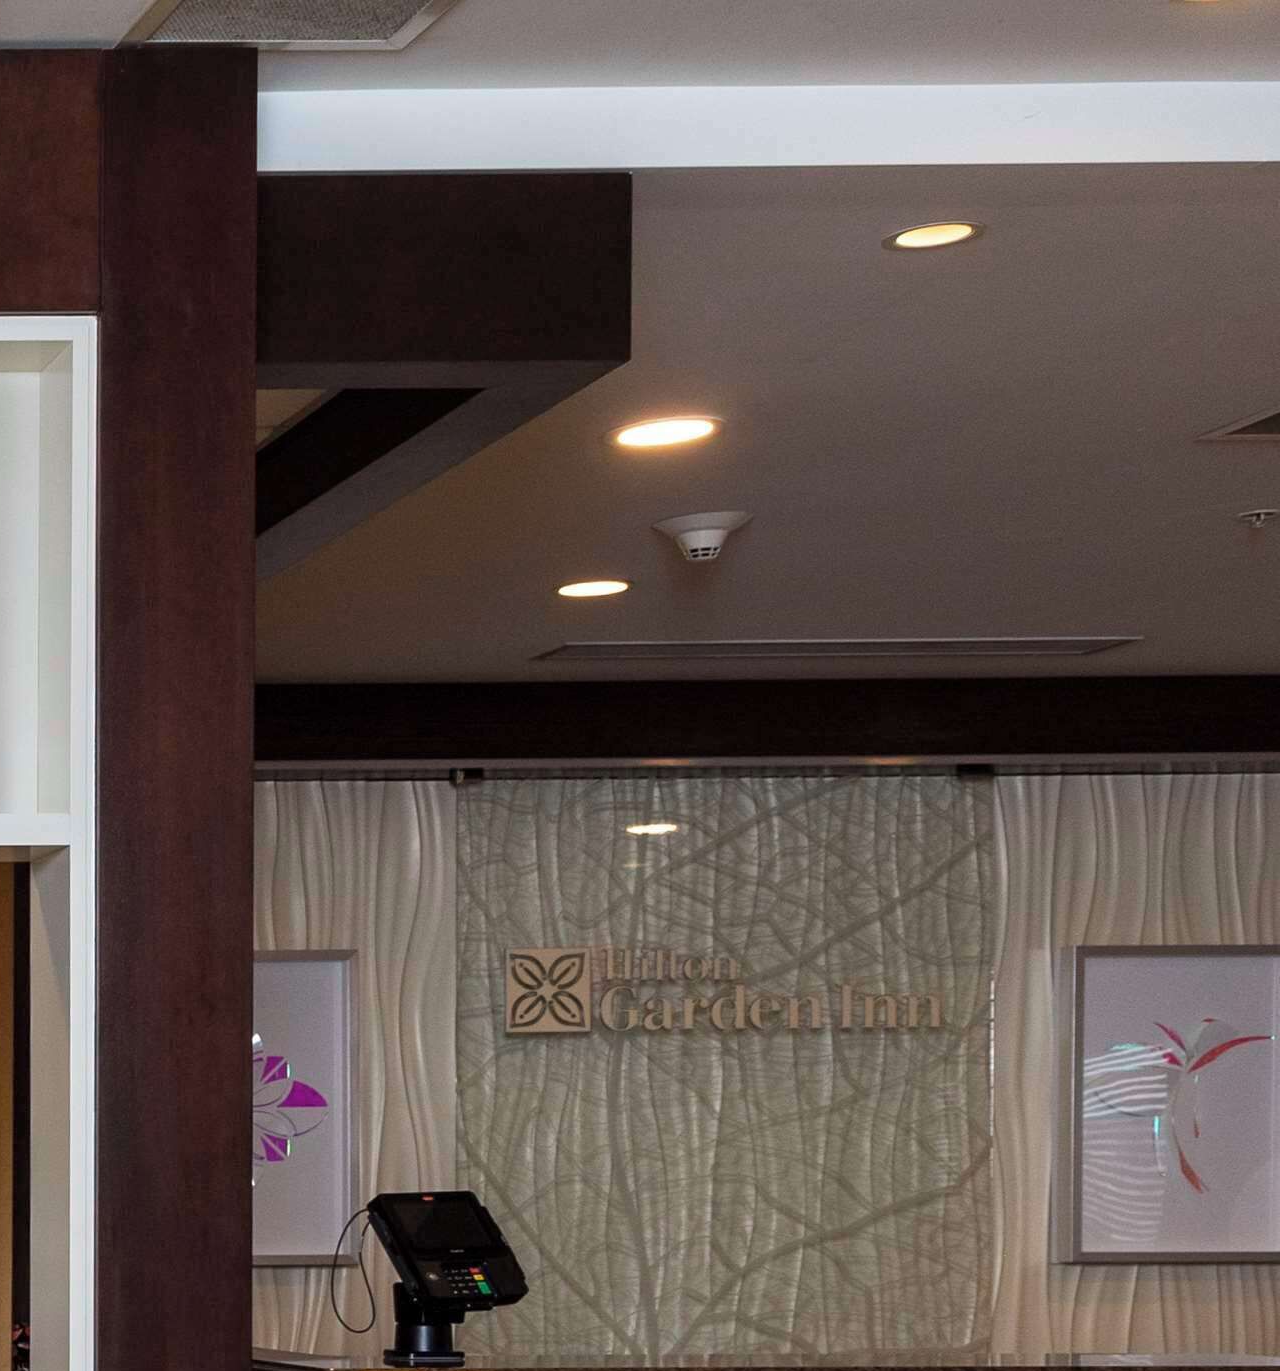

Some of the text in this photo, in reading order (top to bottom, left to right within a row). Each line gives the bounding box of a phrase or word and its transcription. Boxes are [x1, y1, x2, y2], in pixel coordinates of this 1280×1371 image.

[601, 946, 739, 984] Hilton
[598, 982, 941, 1032] Garden Inn
